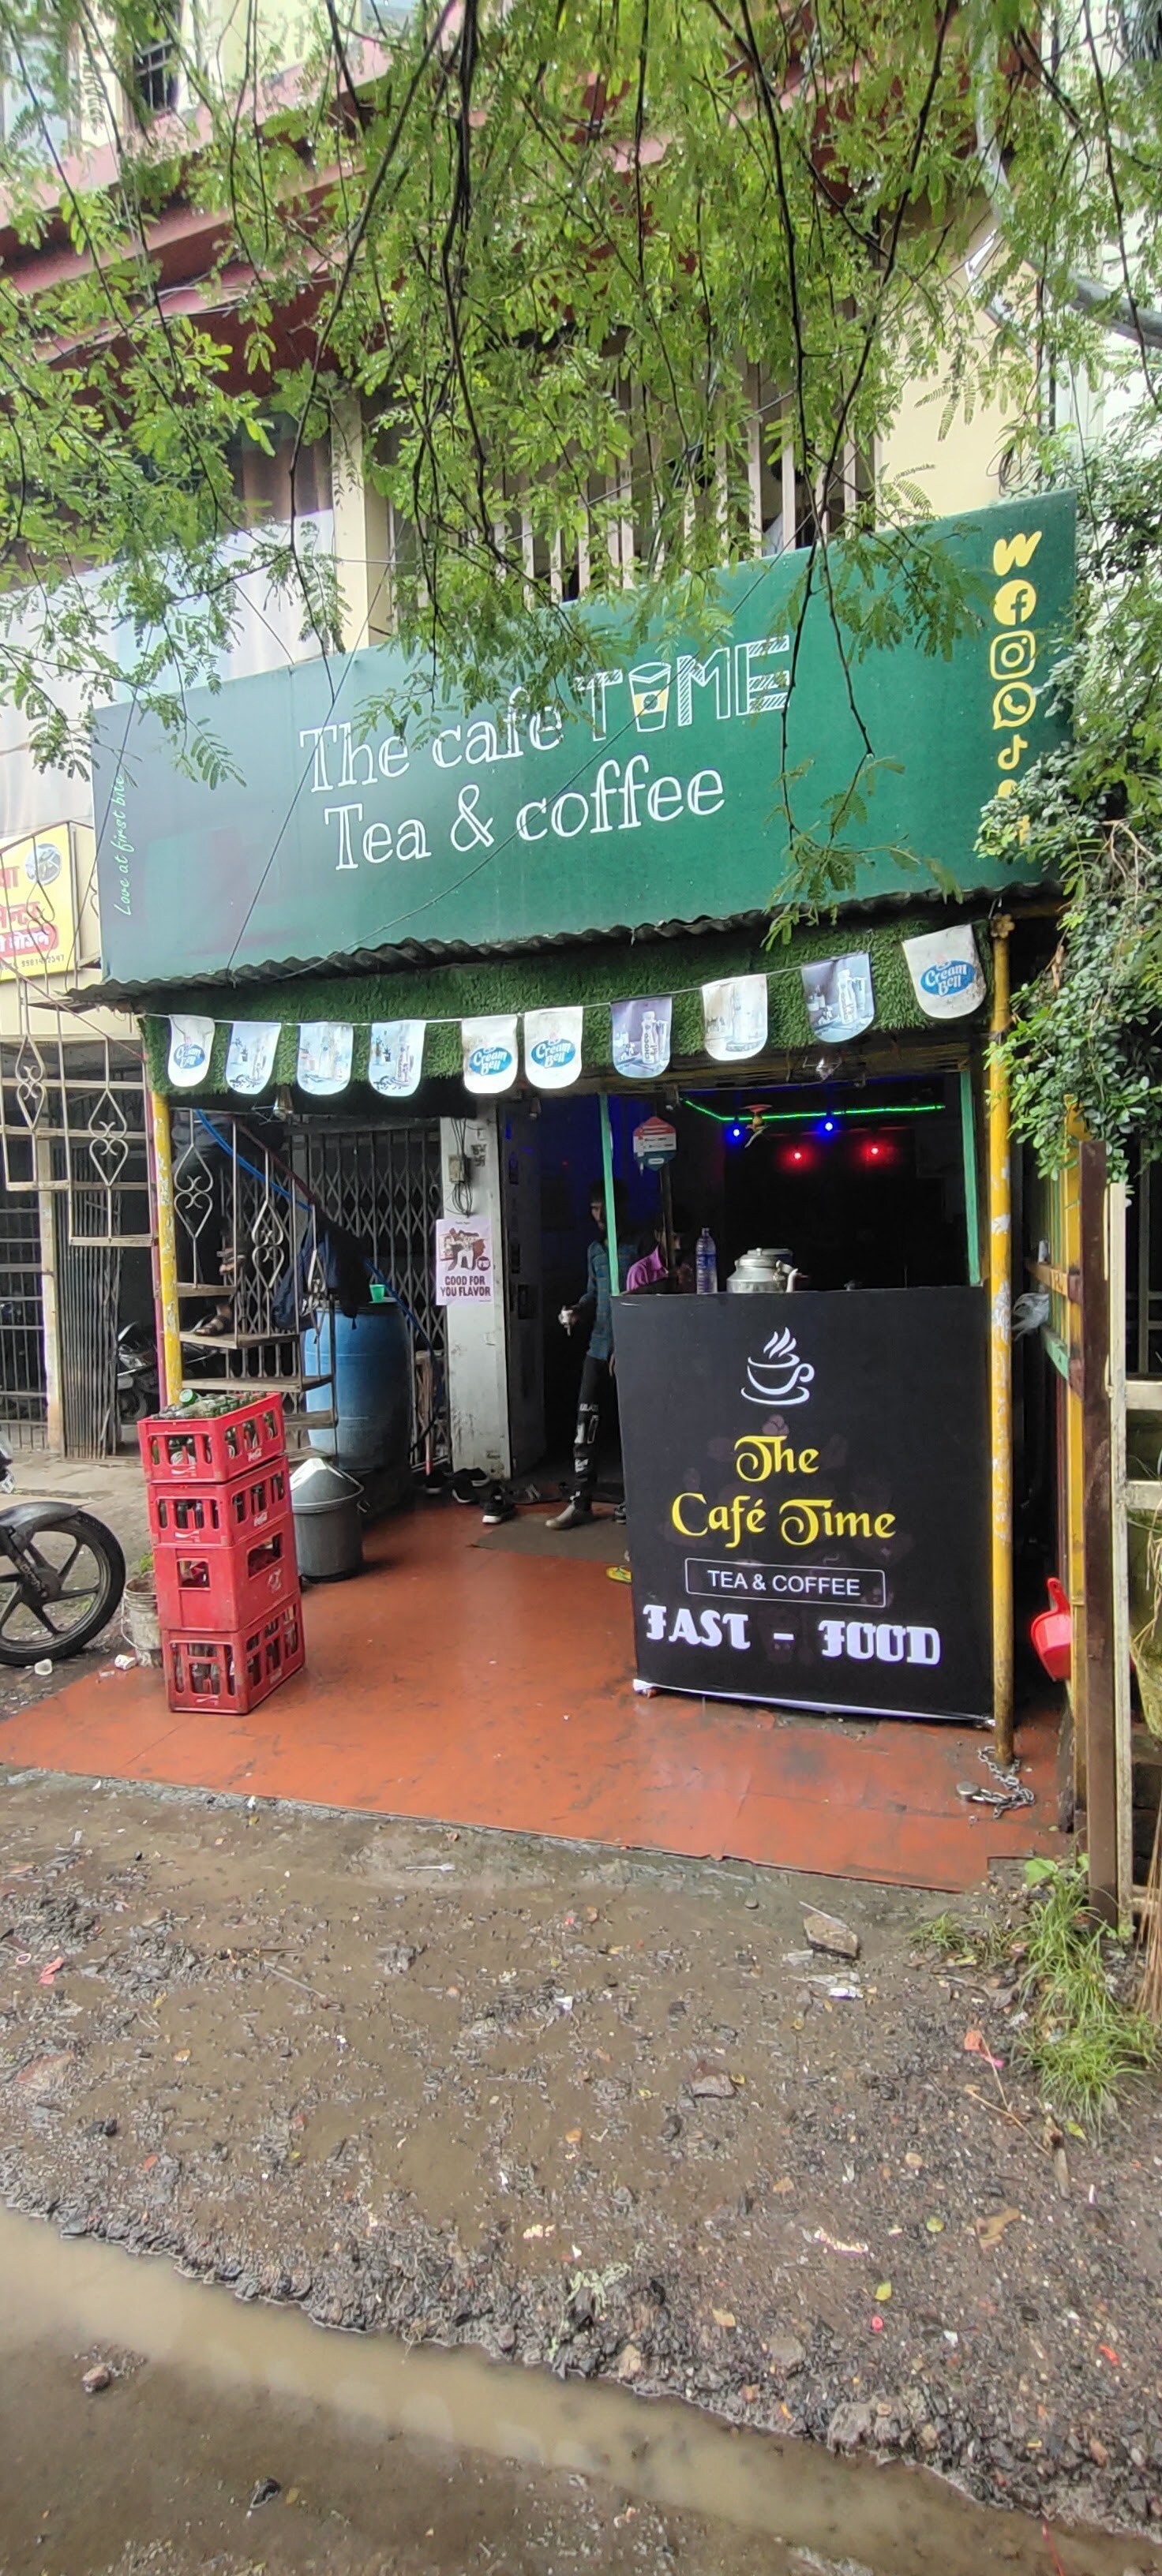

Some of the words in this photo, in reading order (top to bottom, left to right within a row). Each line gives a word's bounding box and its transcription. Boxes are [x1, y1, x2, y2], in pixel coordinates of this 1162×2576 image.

[300, 719, 410, 793] The
[111, 775, 126, 807] bite
[324, 803, 432, 870] Tea
[450, 784, 494, 852] &
[515, 754, 725, 841] coffee
[111, 810, 135, 852] first
[114, 853, 129, 874] at
[114, 878, 132, 915] Love
[925, 964, 967, 987] Cream
[938, 975, 961, 995] Bell
[474, 1050, 508, 1066] Cream
[536, 1043, 572, 1058] Cream
[545, 1051, 565, 1068] Bell
[481, 1058, 501, 1075] Bell
[440, 1286, 457, 1297] YOU
[459, 1286, 491, 1297] FLAVOR
[444, 1275, 467, 1286] GOOD
[469, 1275, 485, 1286] FOR
[734, 1435, 819, 1482] The
[672, 1492, 767, 1548] Café
[779, 1499, 897, 1545] Time
[707, 1570, 748, 1590] TEA
[752, 1574, 767, 1590] &
[772, 1574, 860, 1596] COFFEE
[643, 1604, 751, 1649] FAST
[818, 1620, 941, 1665] FOOD
